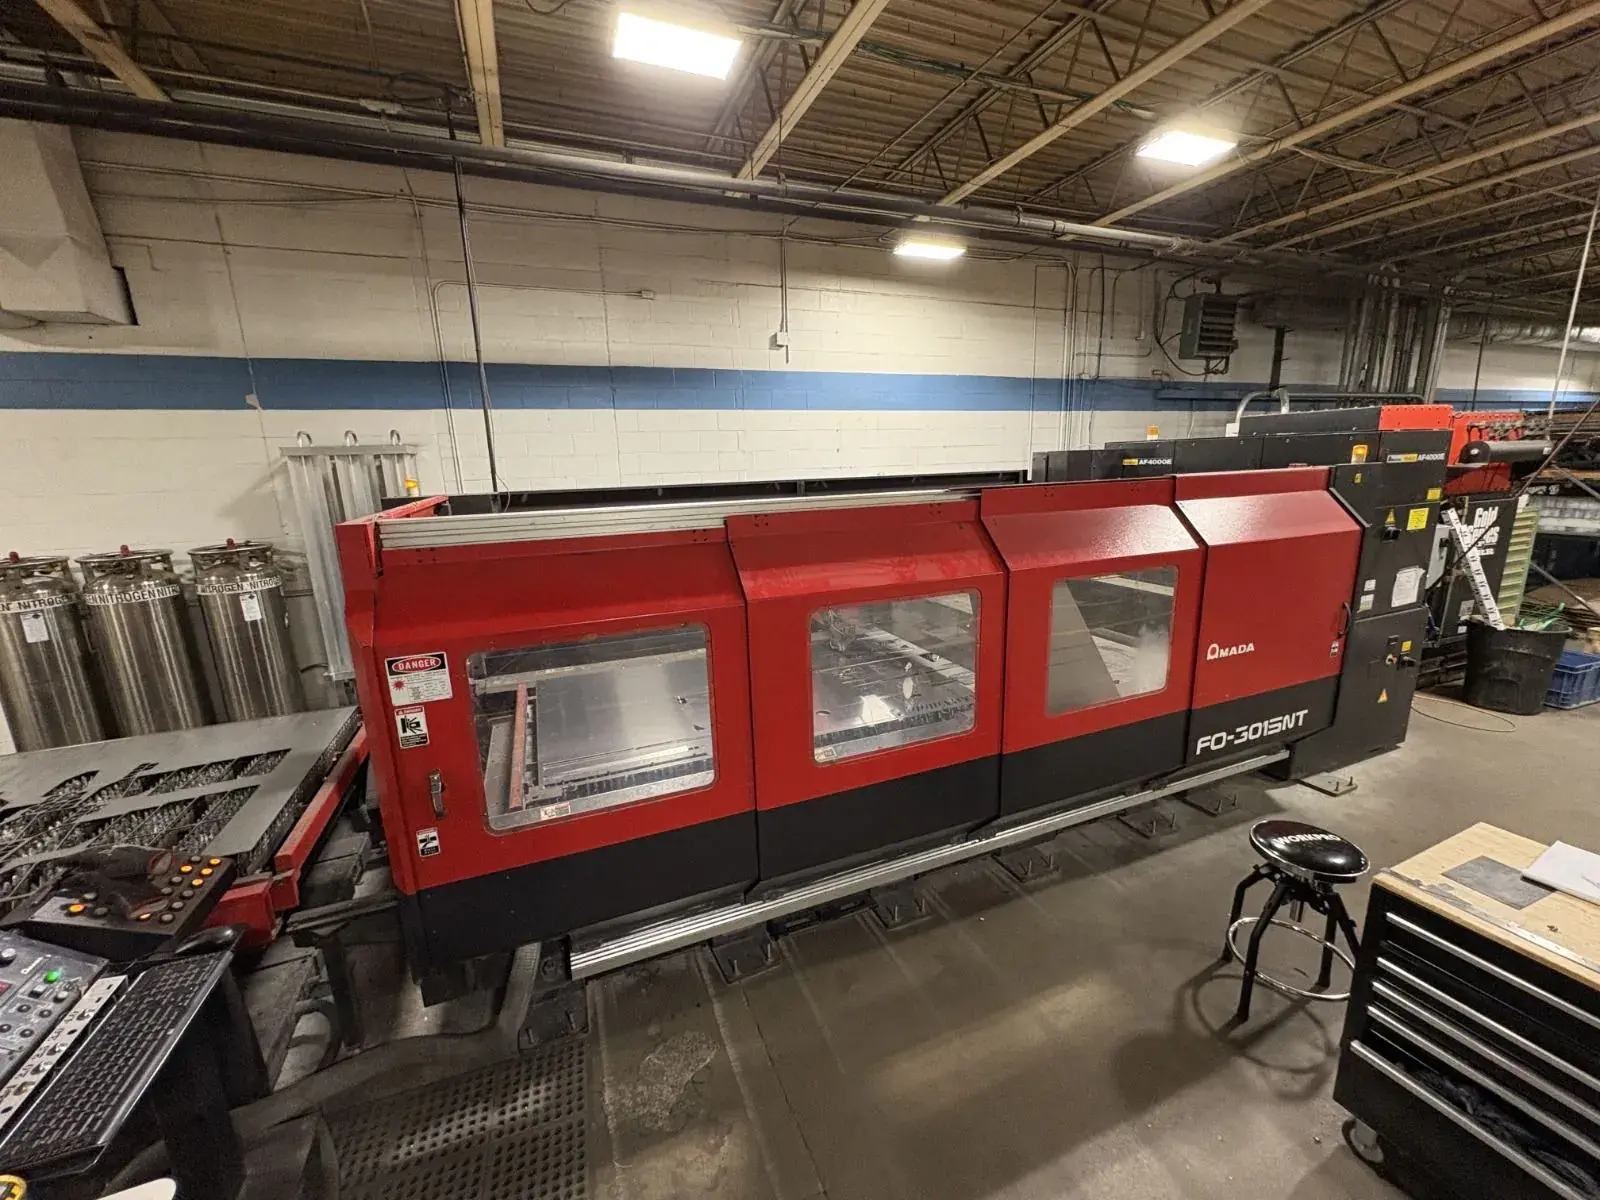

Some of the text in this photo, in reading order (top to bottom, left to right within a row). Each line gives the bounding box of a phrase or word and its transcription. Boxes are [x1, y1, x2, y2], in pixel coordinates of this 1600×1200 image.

[1474, 506, 1499, 529] Gold
[1207, 642, 1255, 661] AMADA
[398, 659, 436, 671] DANGER
[1195, 709, 1309, 756] FO-3015NT
[1272, 833, 1342, 845] WORKPRO
